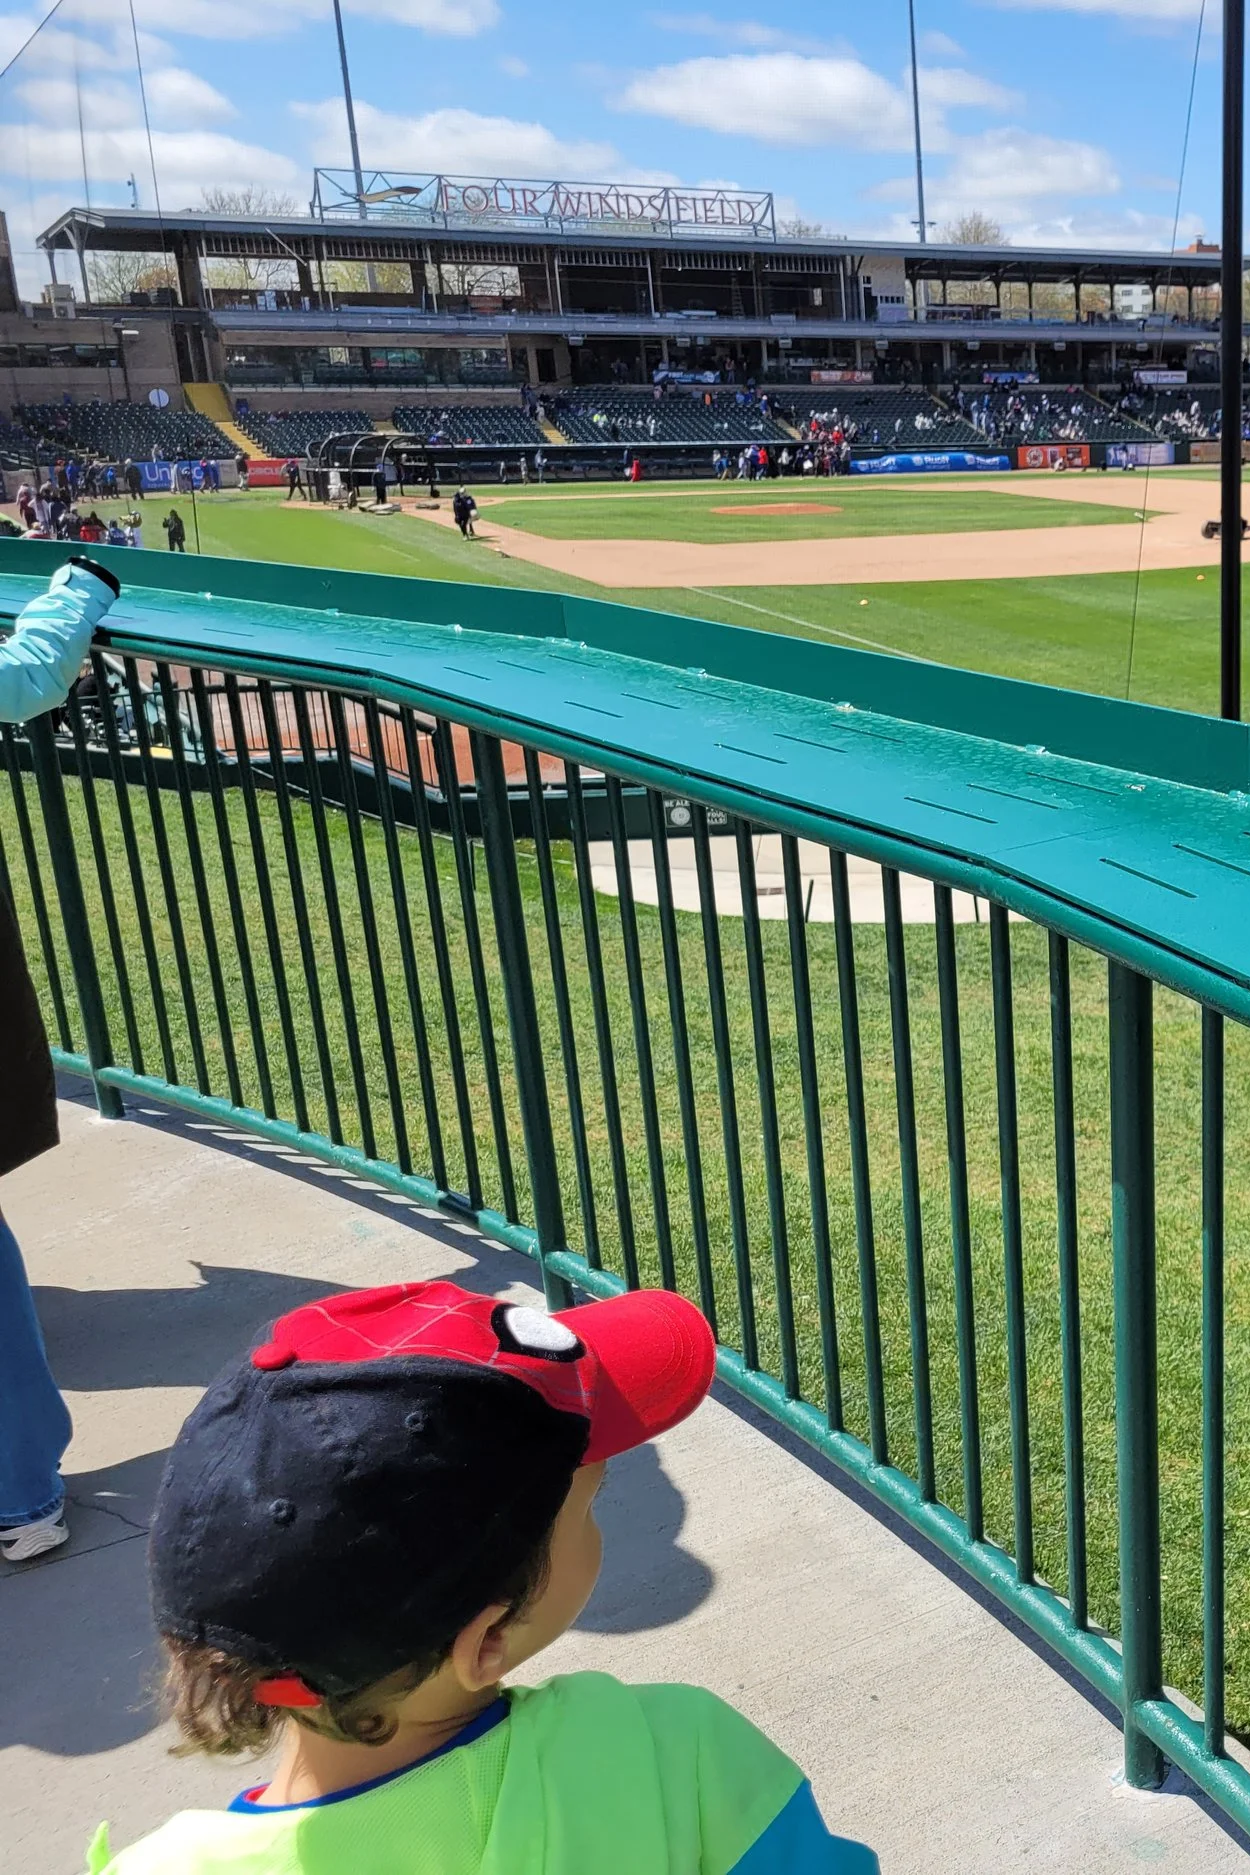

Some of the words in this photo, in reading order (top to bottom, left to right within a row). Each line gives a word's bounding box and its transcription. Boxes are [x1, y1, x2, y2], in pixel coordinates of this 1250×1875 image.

[442, 184, 543, 216] FOUR
[553, 188, 662, 223] WINDS
[675, 196, 757, 226] FIELD
